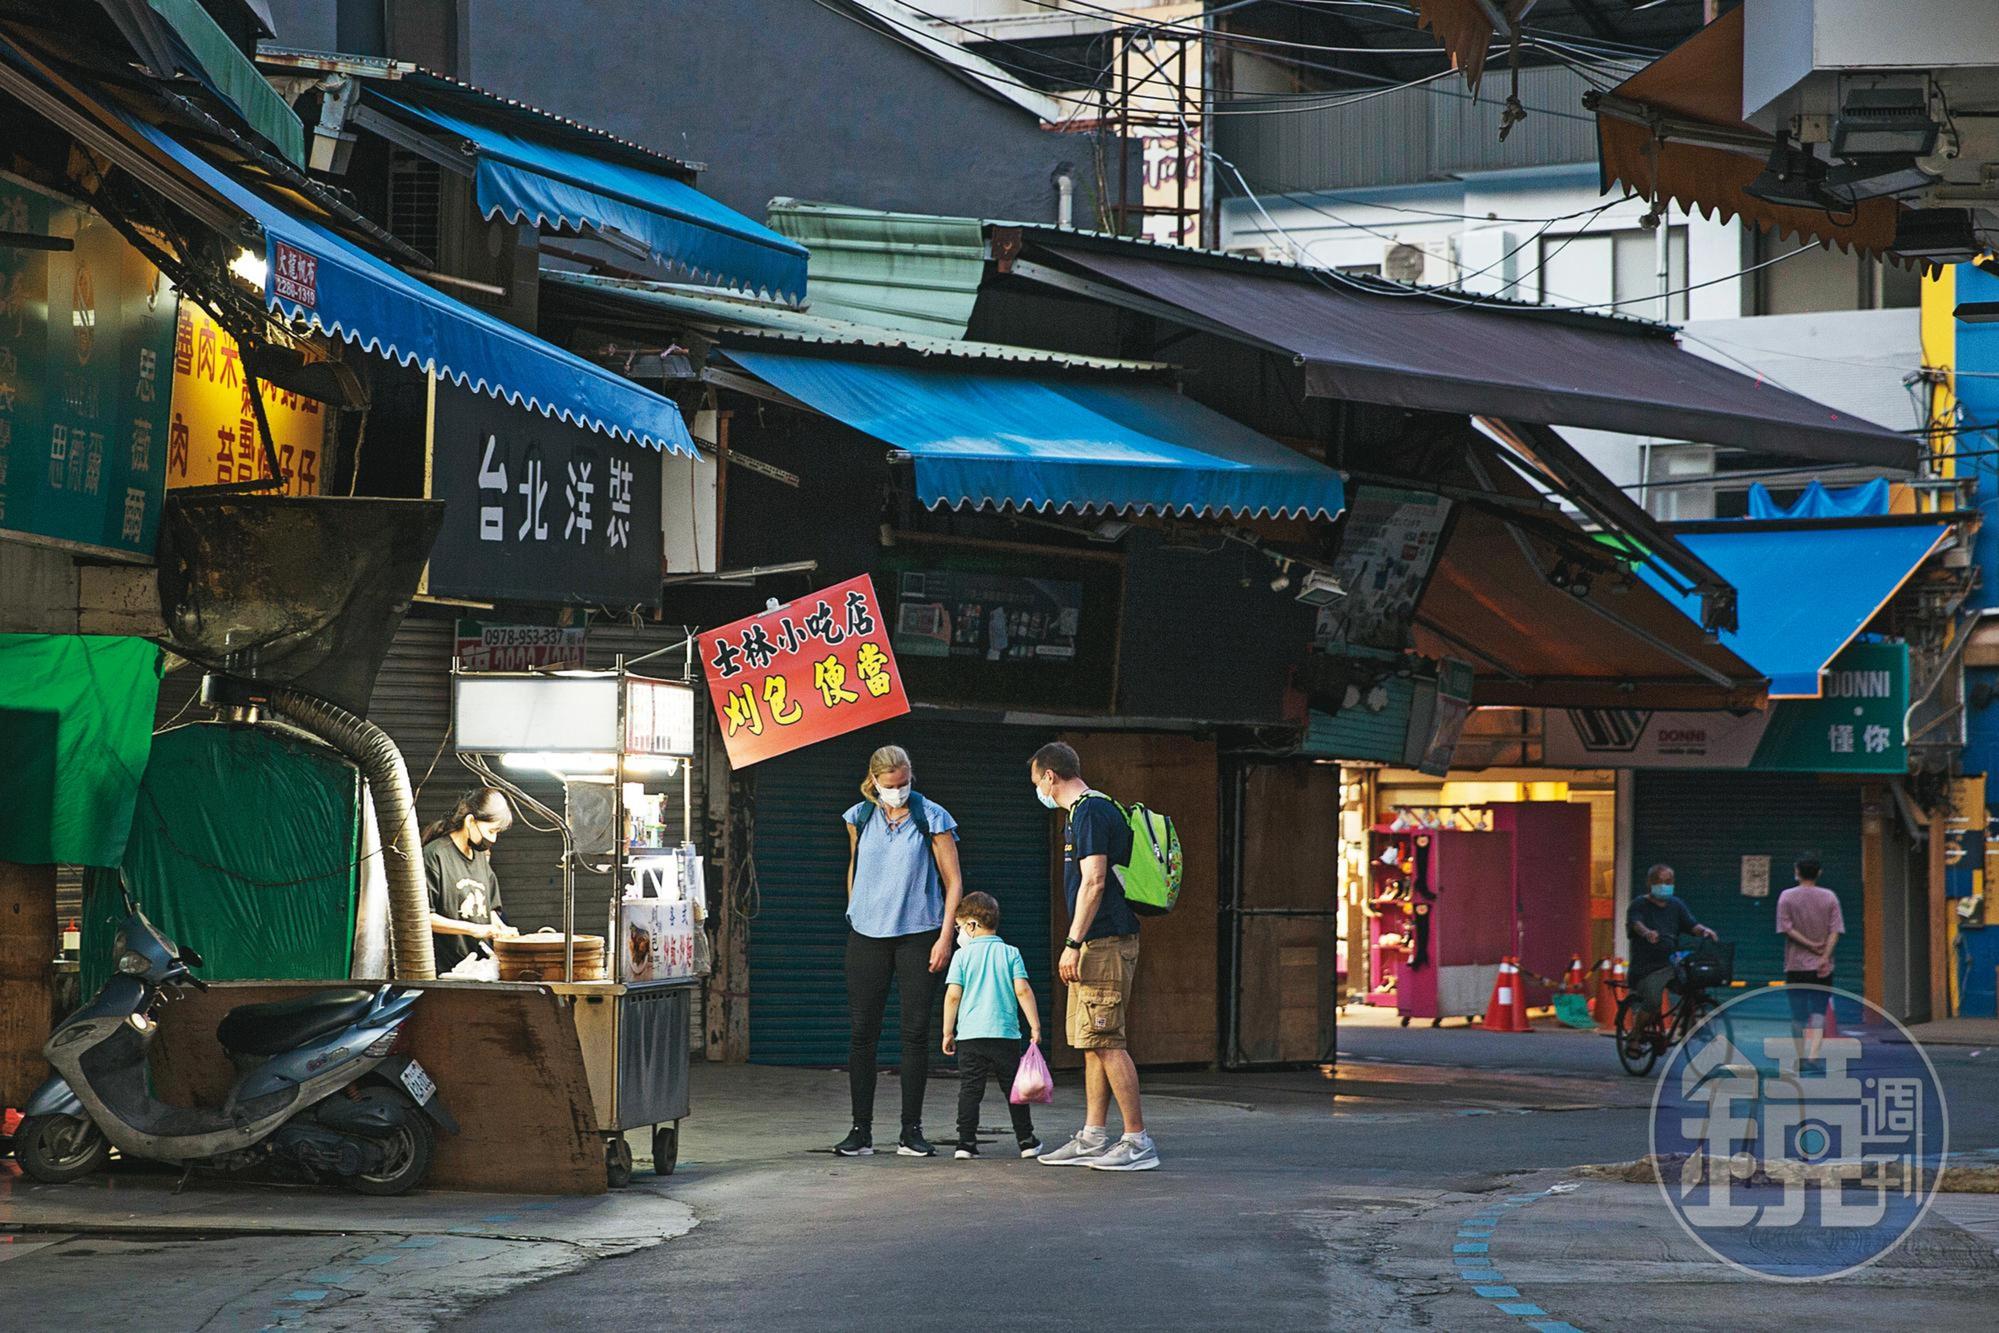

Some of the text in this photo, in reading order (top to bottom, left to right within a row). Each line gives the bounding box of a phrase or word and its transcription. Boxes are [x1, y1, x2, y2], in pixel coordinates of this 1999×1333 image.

[478, 434, 634, 549] 台北洋裝
[485, 628, 565, 646] 0978-953-337
[711, 590, 876, 680] 士林小吃店
[722, 674, 804, 738] 刈包
[813, 641, 892, 709] 便當
[1828, 670, 1890, 698] DONNI
[1828, 723, 1890, 754] 懂你
